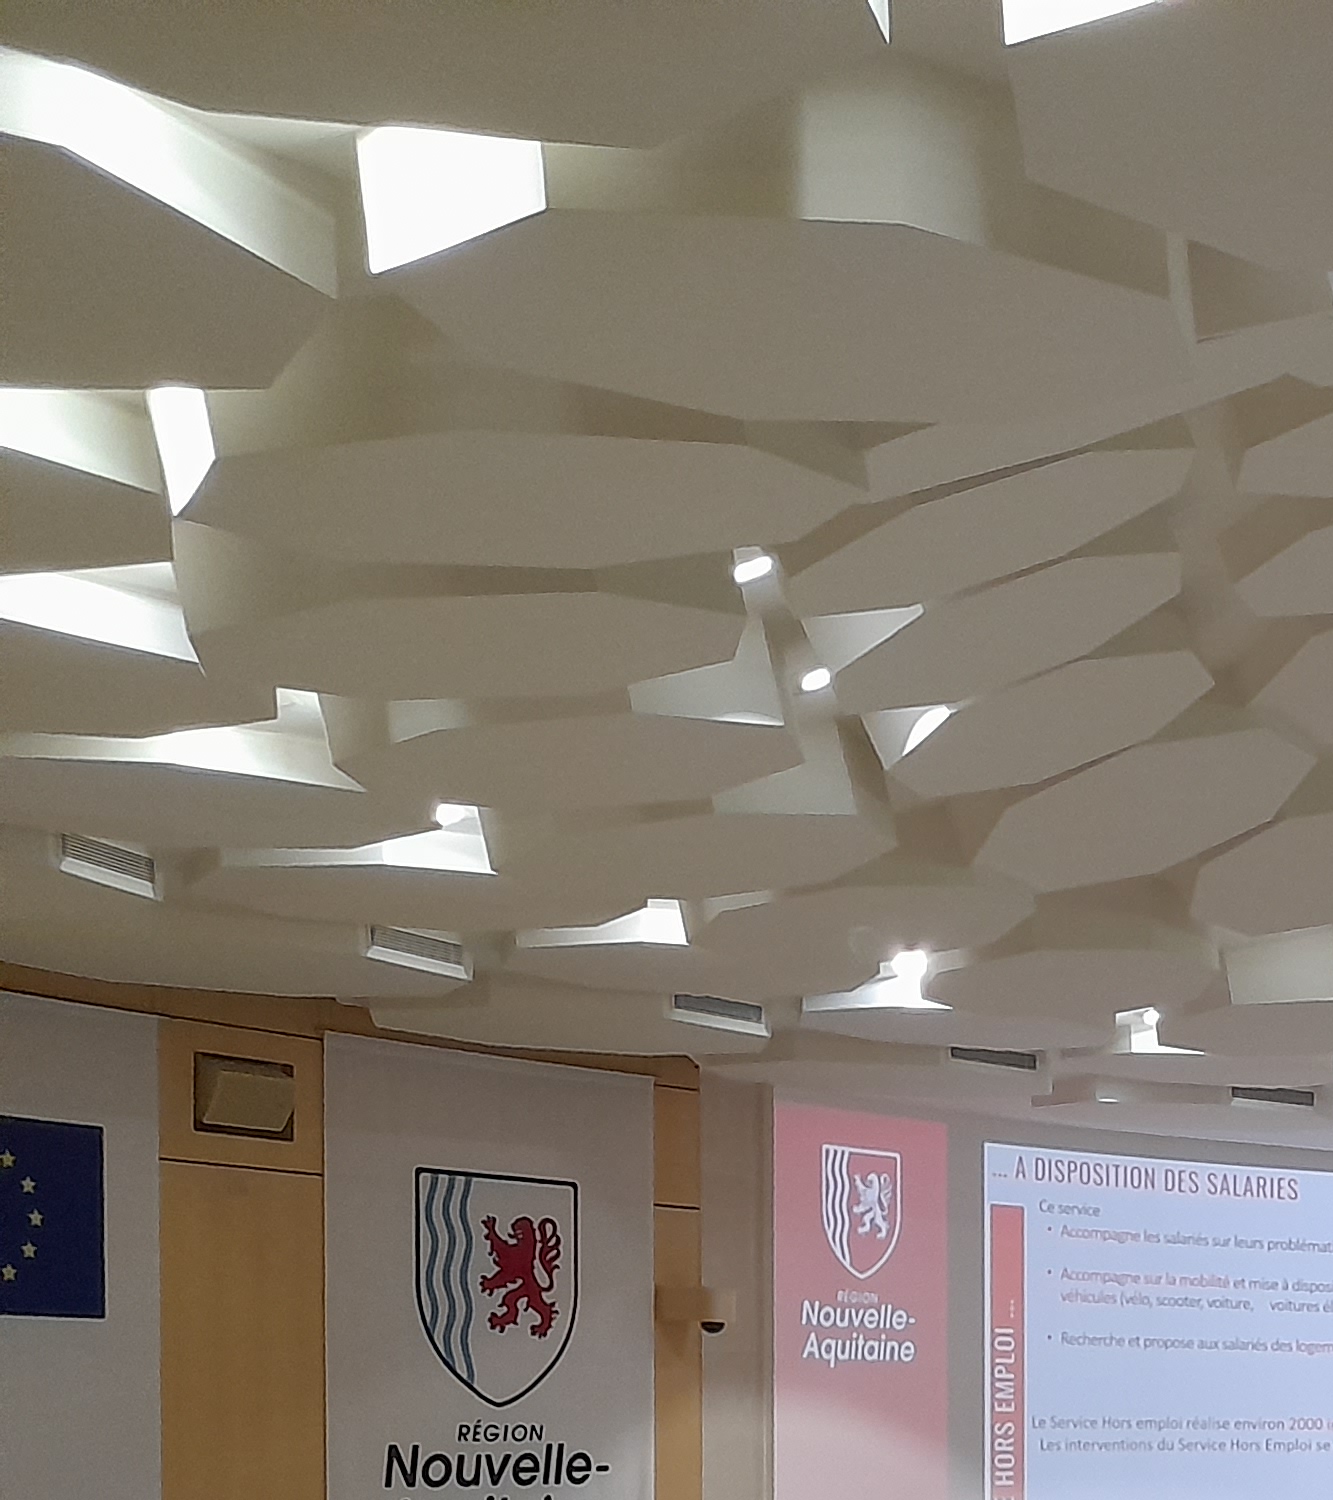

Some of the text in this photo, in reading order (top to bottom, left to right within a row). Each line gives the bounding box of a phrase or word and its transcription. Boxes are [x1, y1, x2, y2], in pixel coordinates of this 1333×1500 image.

[1014, 1155, 1027, 1180] A
[1034, 1157, 1156, 1190] DISPOSITION
[1164, 1168, 1200, 1194] DES
[1207, 1172, 1299, 1200] SALARIES
[1039, 1199, 1101, 1218] Ce service
[1060, 1224, 1141, 1245] Accompagne
[1143, 1229, 1161, 1244] les
[1163, 1231, 1210, 1247] salariés
[1212, 1237, 1231, 1248] sur
[1234, 1235, 1265, 1250] leurs
[1060, 1267, 1141, 1287] Accompagne
[1143, 1273, 1163, 1286] sur
[1165, 1271, 1177, 1286] la
[1179, 1272, 1230, 1289] mobilité
[1233, 1278, 1247, 1290] et
[1249, 1277, 1279, 1291] mise
[1281, 1277, 1289, 1291] à
[1060, 1289, 1117, 1306] véhicules
[1156, 1295, 1204, 1311] scooter,
[1206, 1297, 1254, 1313] voiture,
[1269, 1299, 1321, 1314] voitures
[801, 1299, 916, 1331] Nouvelle-
[802, 1331, 916, 1369] Aquitaine
[1060, 1331, 1126, 1348] Recherche
[1127, 1334, 1142, 1348] et
[1143, 1337, 1195, 1351] propose
[1196, 1339, 1219, 1351] aux
[1221, 1336, 1269, 1352] salariés
[1270, 1339, 1294, 1353] des
[993, 1327, 1016, 1413] EMPLOI
[456, 1418, 545, 1443] RÉGION
[1031, 1415, 1047, 1429] Le
[1049, 1415, 1098, 1430] Service
[1101, 1415, 1133, 1430] Hors
[1135, 1415, 1183, 1432] emploi
[1186, 1415, 1231, 1431] réalise
[1233, 1417, 1286, 1432] environ
[1288, 1417, 1324, 1431] 2000
[993, 1422, 1016, 1486] HORS
[1039, 1437, 1063, 1452] Les
[1064, 1437, 1154, 1452] interventions
[1156, 1437, 1176, 1452] du
[1177, 1437, 1228, 1452] Service
[1229, 1438, 1262, 1452] Hors
[1264, 1437, 1314, 1454] Emploi
[1315, 1441, 1332, 1452] se
[383, 1442, 610, 1489] Nouvelle-
